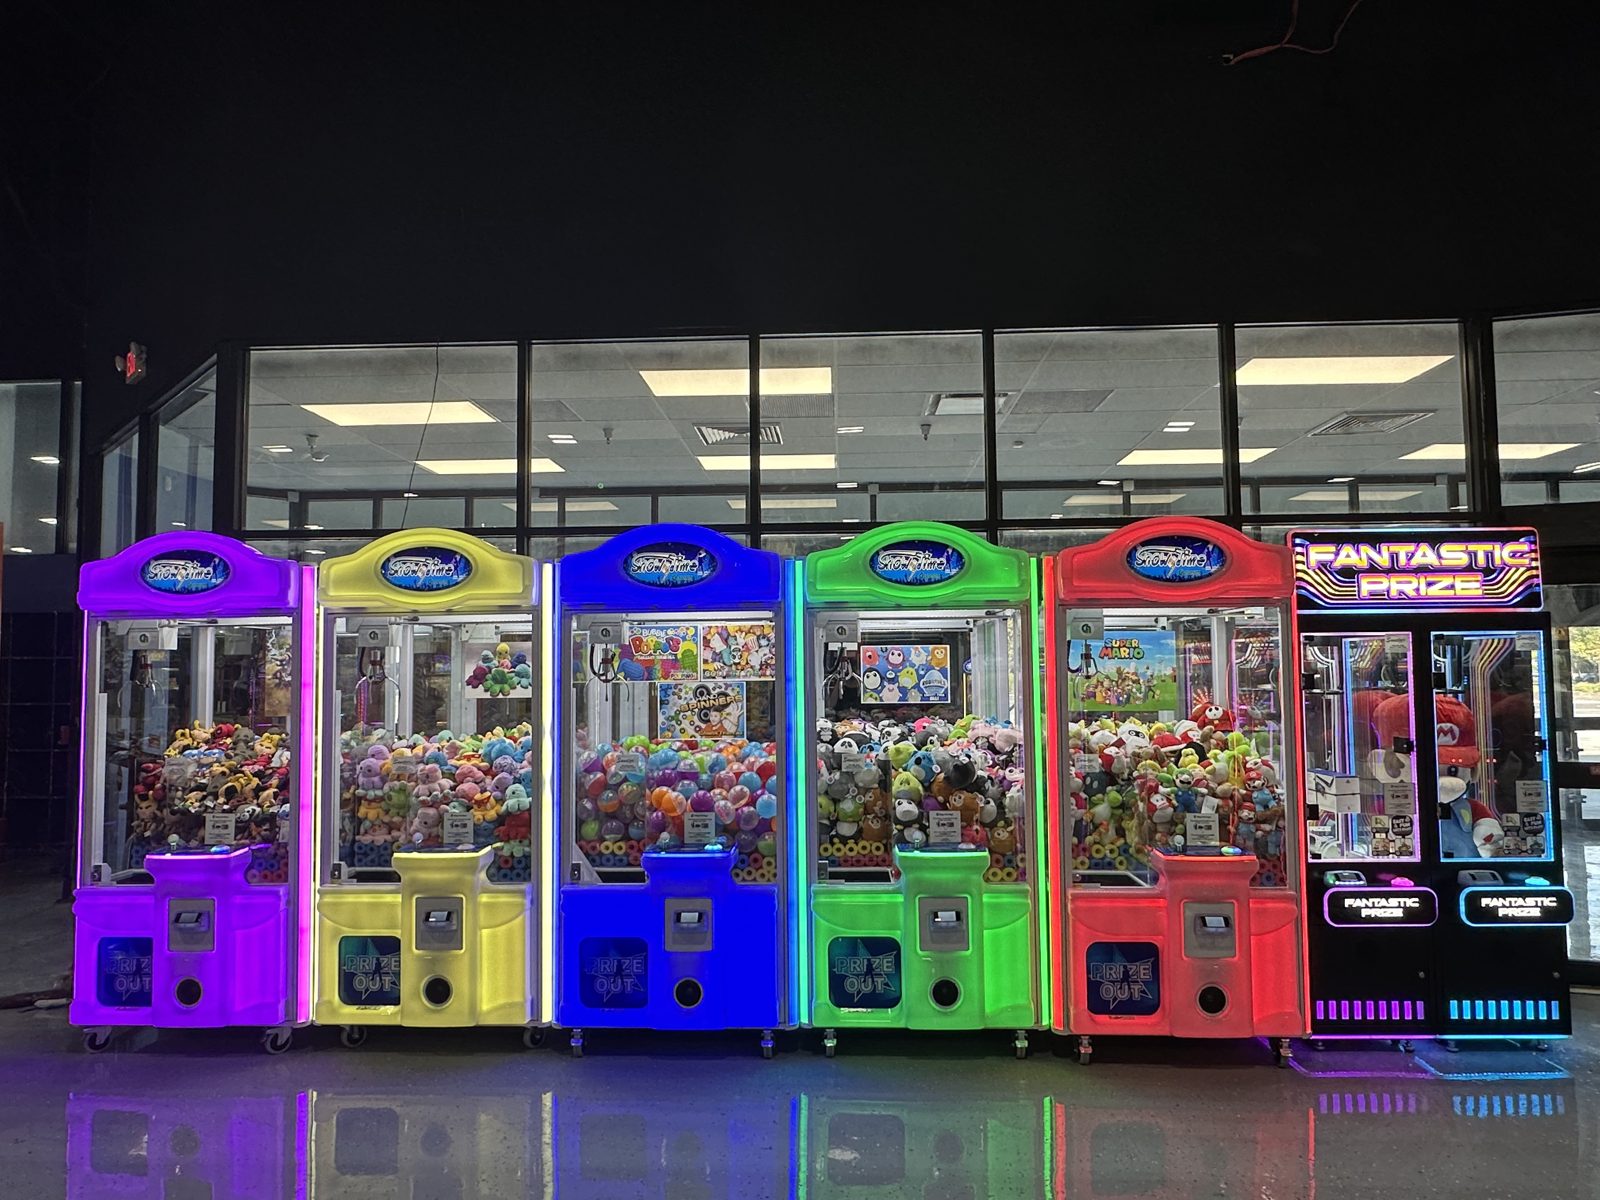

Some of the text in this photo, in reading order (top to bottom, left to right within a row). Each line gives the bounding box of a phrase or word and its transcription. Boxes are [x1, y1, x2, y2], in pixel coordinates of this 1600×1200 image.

[1306, 542, 1532, 569] FANTASTIC
[1356, 572, 1485, 600] PRIZE
[1104, 637, 1139, 648] SUPER
[1099, 647, 1145, 660] MARIO
[680, 694, 743, 713] SPINNERS
[1344, 897, 1420, 908] FANTASTIC
[1480, 896, 1558, 907] FANTASTIC
[1360, 907, 1404, 918] PRIZE
[1498, 907, 1541, 917] PRIZE
[106, 956, 151, 974] PRIZ
[345, 955, 400, 972] PRIZE
[586, 956, 644, 975] PRIZE
[836, 957, 895, 975] PRIZE
[1090, 962, 1153, 981] PRIZE
[115, 976, 151, 993] OUT
[352, 974, 394, 992] OUT
[594, 976, 635, 993] OUT
[844, 975, 887, 994] OUT
[1099, 981, 1144, 1000] OUT
